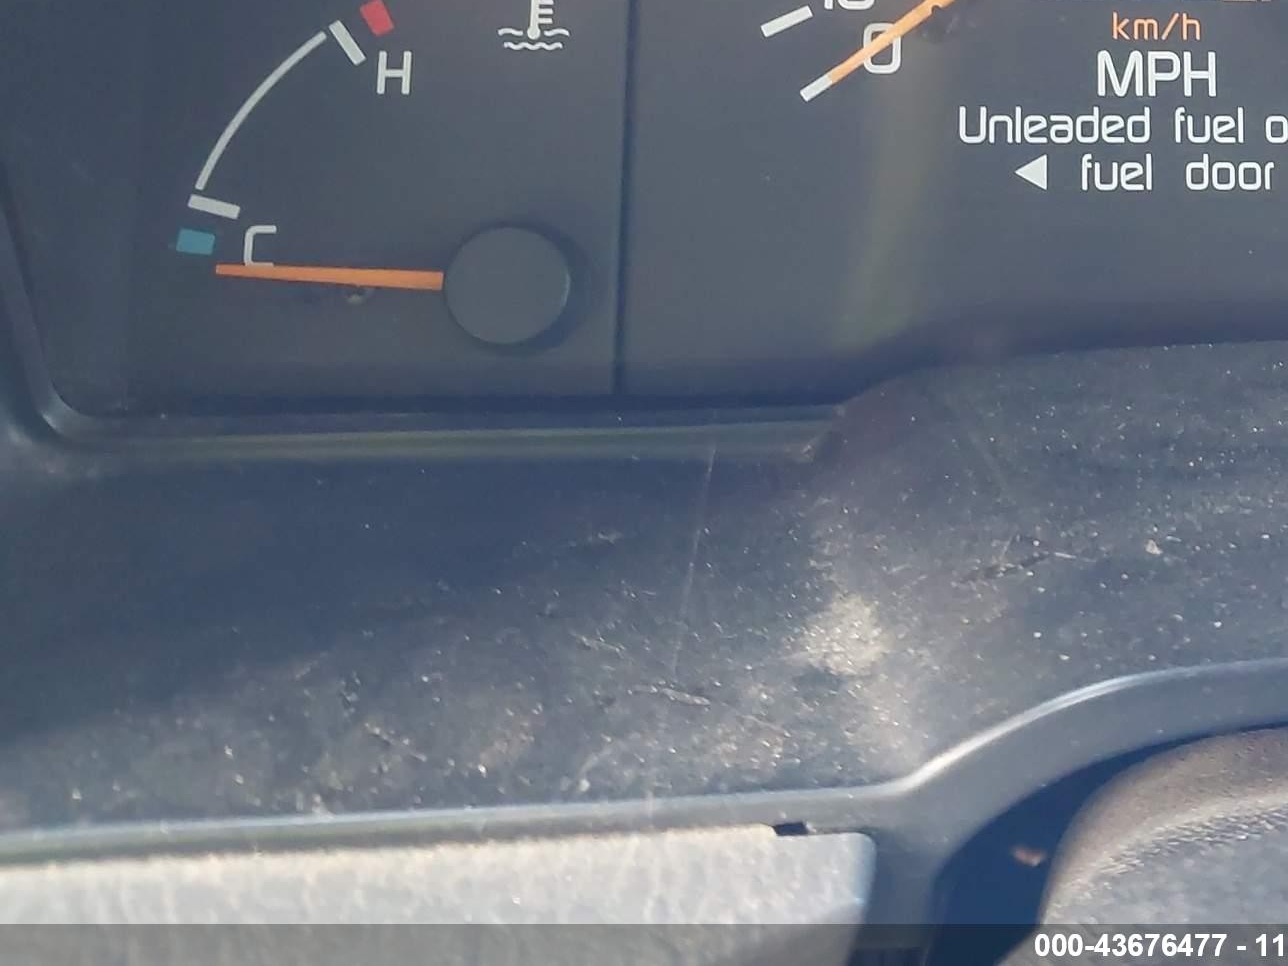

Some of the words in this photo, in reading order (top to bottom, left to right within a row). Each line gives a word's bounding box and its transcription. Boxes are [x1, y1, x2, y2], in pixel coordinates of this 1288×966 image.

[1112, 12, 1201, 41] km/h
[863, 22, 901, 74] 0
[376, 50, 412, 95] H
[1097, 50, 1217, 97] MPH
[959, 106, 1151, 144] Unleaded
[1174, 106, 1244, 144] fuel
[1081, 153, 1153, 191] fuel
[1185, 153, 1275, 191] door
[244, 224, 278, 265] C
